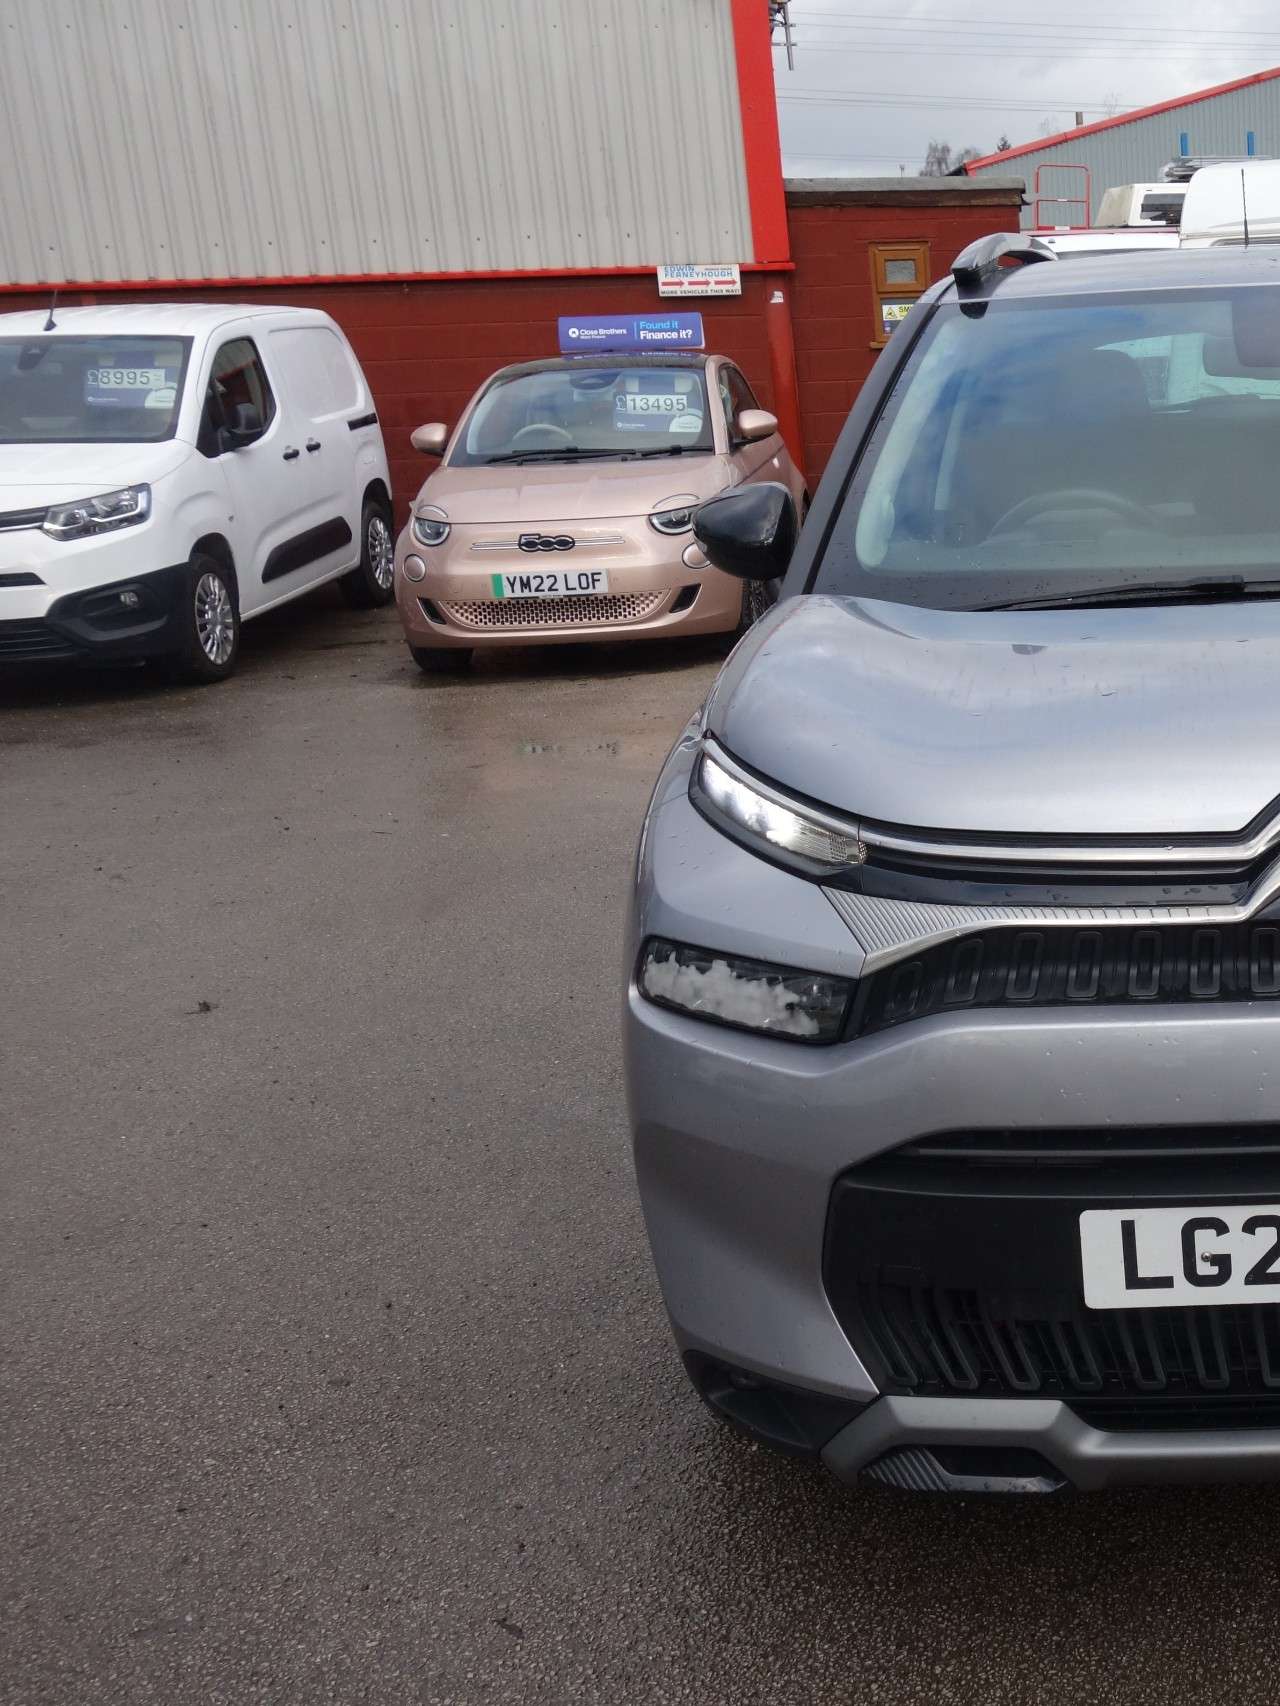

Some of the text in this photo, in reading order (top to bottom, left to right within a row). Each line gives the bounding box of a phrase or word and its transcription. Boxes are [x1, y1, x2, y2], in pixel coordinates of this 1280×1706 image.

[640, 319, 679, 329] Found it
[640, 329, 693, 340] Finance it?
[615, 395, 686, 412] £13495
[518, 533, 575, 552] 500
[505, 572, 602, 593] YM22 LOF
